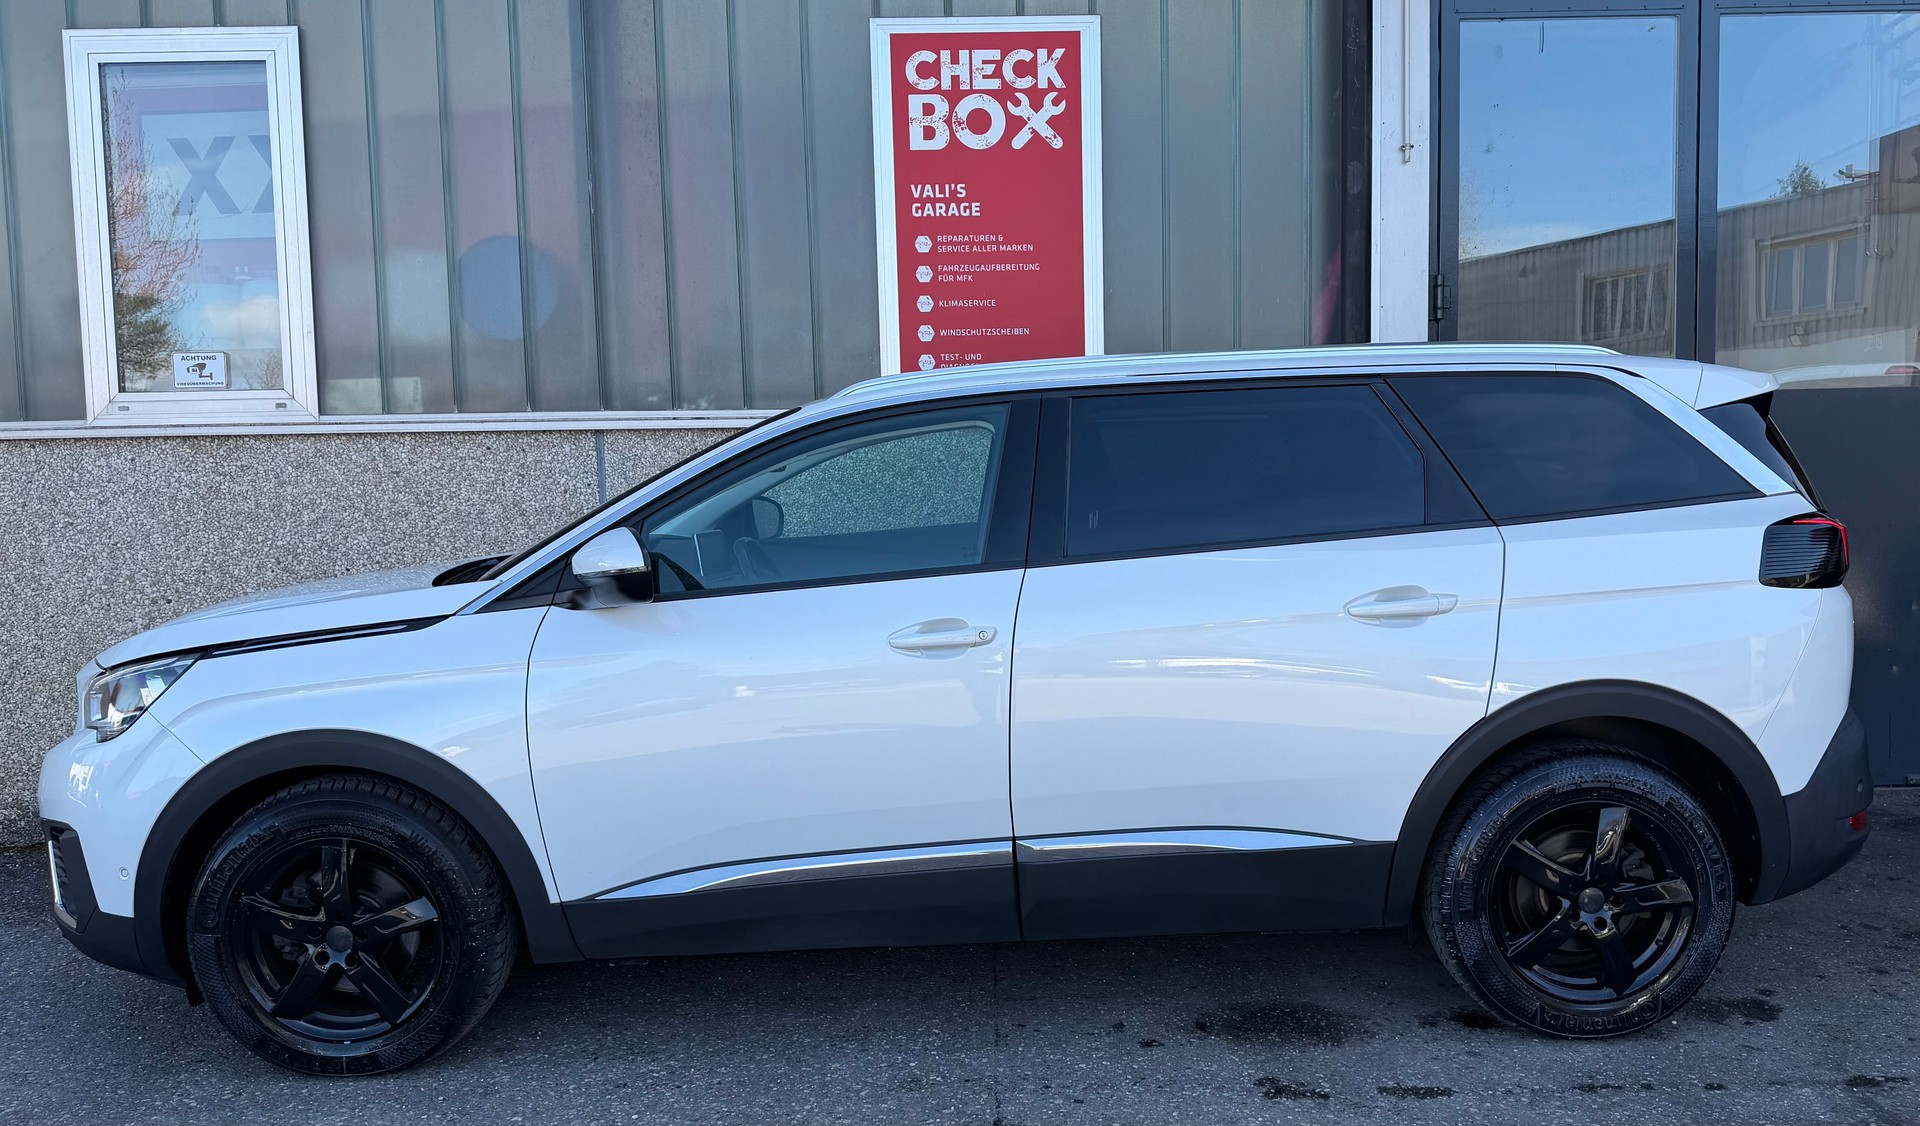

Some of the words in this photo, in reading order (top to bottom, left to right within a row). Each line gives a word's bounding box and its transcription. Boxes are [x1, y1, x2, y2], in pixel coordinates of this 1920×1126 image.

[905, 48, 1067, 90] CHECK
[908, 91, 1067, 150] BOX
[911, 183, 967, 199] VALI'S
[911, 202, 981, 217] GARAGE
[937, 234, 996, 243] REPARATUREN
[998, 234, 1004, 242] &
[937, 244, 970, 253] SERVICE
[972, 244, 997, 252] ALLER
[999, 244, 1034, 252] MARKEN
[938, 263, 1040, 272] FAHRZEUGAUFBEREITUNG
[938, 274, 955, 283] FÜR
[956, 274, 973, 283] MFK
[938, 299, 996, 308] KLIMASERVICE
[939, 327, 1030, 337] WINDSCHUTZSCHEIBEN
[180, 354, 217, 362] ACHTUNG
[940, 353, 963, 361] TEST-
[964, 353, 982, 361] UND
